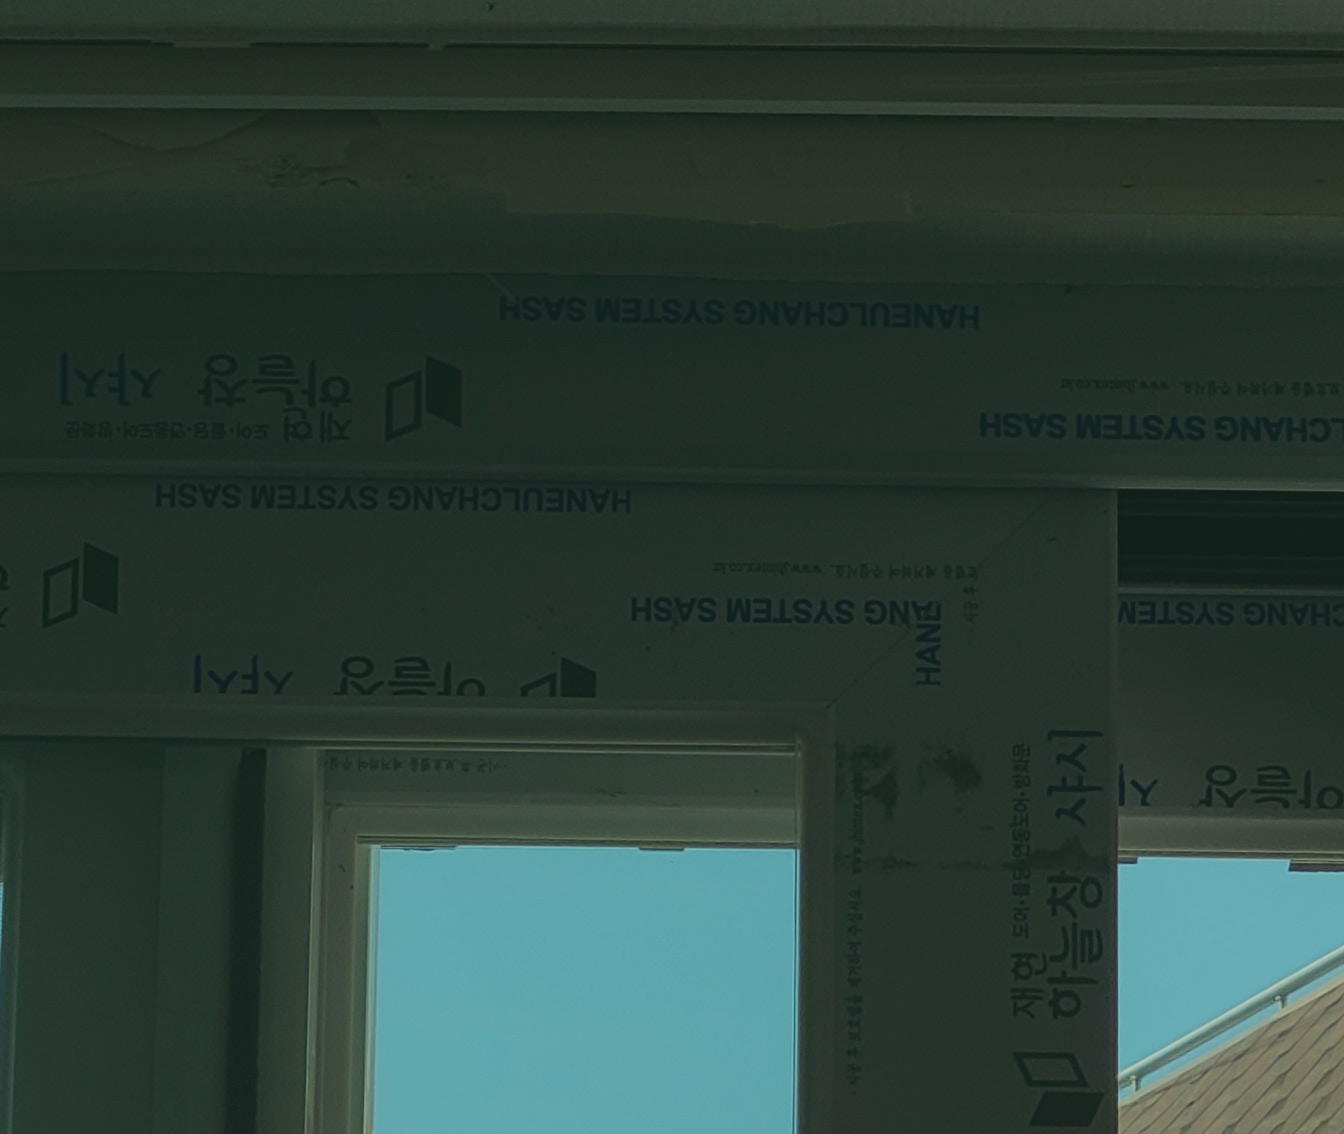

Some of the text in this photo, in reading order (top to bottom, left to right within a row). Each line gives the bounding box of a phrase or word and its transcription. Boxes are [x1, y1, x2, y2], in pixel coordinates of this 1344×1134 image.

[498, 295, 980, 329] HANEULCHANG SYSTEM SASH
[59, 351, 352, 407] 하늘창 샤시
[283, 407, 352, 443] 재현
[978, 411, 1068, 440] SASH
[1075, 413, 1207, 442] SYSTEM
[154, 482, 632, 514] HANEULCHANG SYSTEM SASH
[630, 596, 717, 623] SASH
[726, 597, 856, 625] SYSTEM
[1046, 729, 1104, 1021] 하늘창 샤시
[1009, 951, 1047, 1020] 재현
